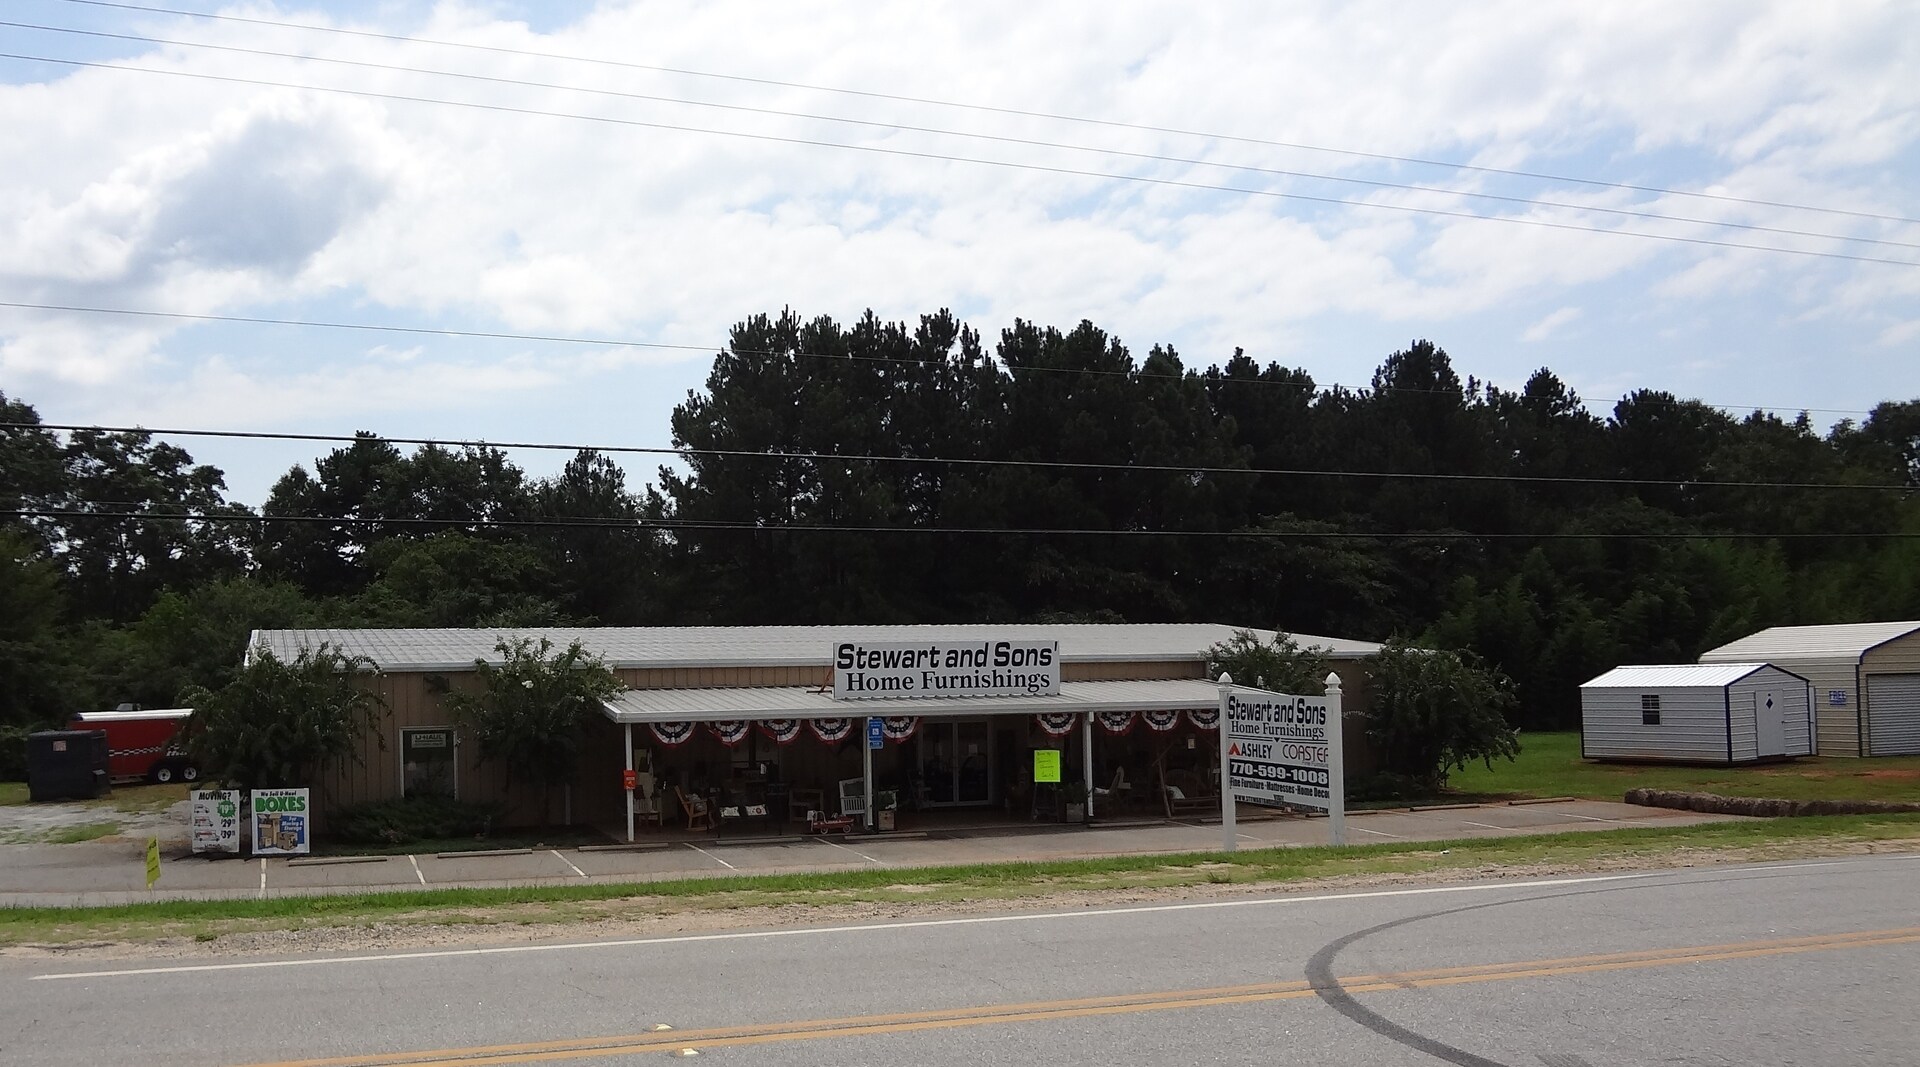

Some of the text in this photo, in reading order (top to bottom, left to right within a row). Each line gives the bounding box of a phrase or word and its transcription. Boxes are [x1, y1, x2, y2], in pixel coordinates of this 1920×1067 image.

[837, 641, 1058, 669] Stewart and Sons'
[846, 669, 1050, 693] Home Furnishings
[1228, 696, 1326, 725] Stewart and Sons
[1231, 721, 1324, 740] Home Furnishings
[1241, 743, 1272, 759] ASHLEY
[1231, 762, 1328, 784] 770-599-1008
[1241, 779, 1264, 789] Furniture
[1296, 784, 1313, 797] Home
[255, 796, 306, 812] BOXES
